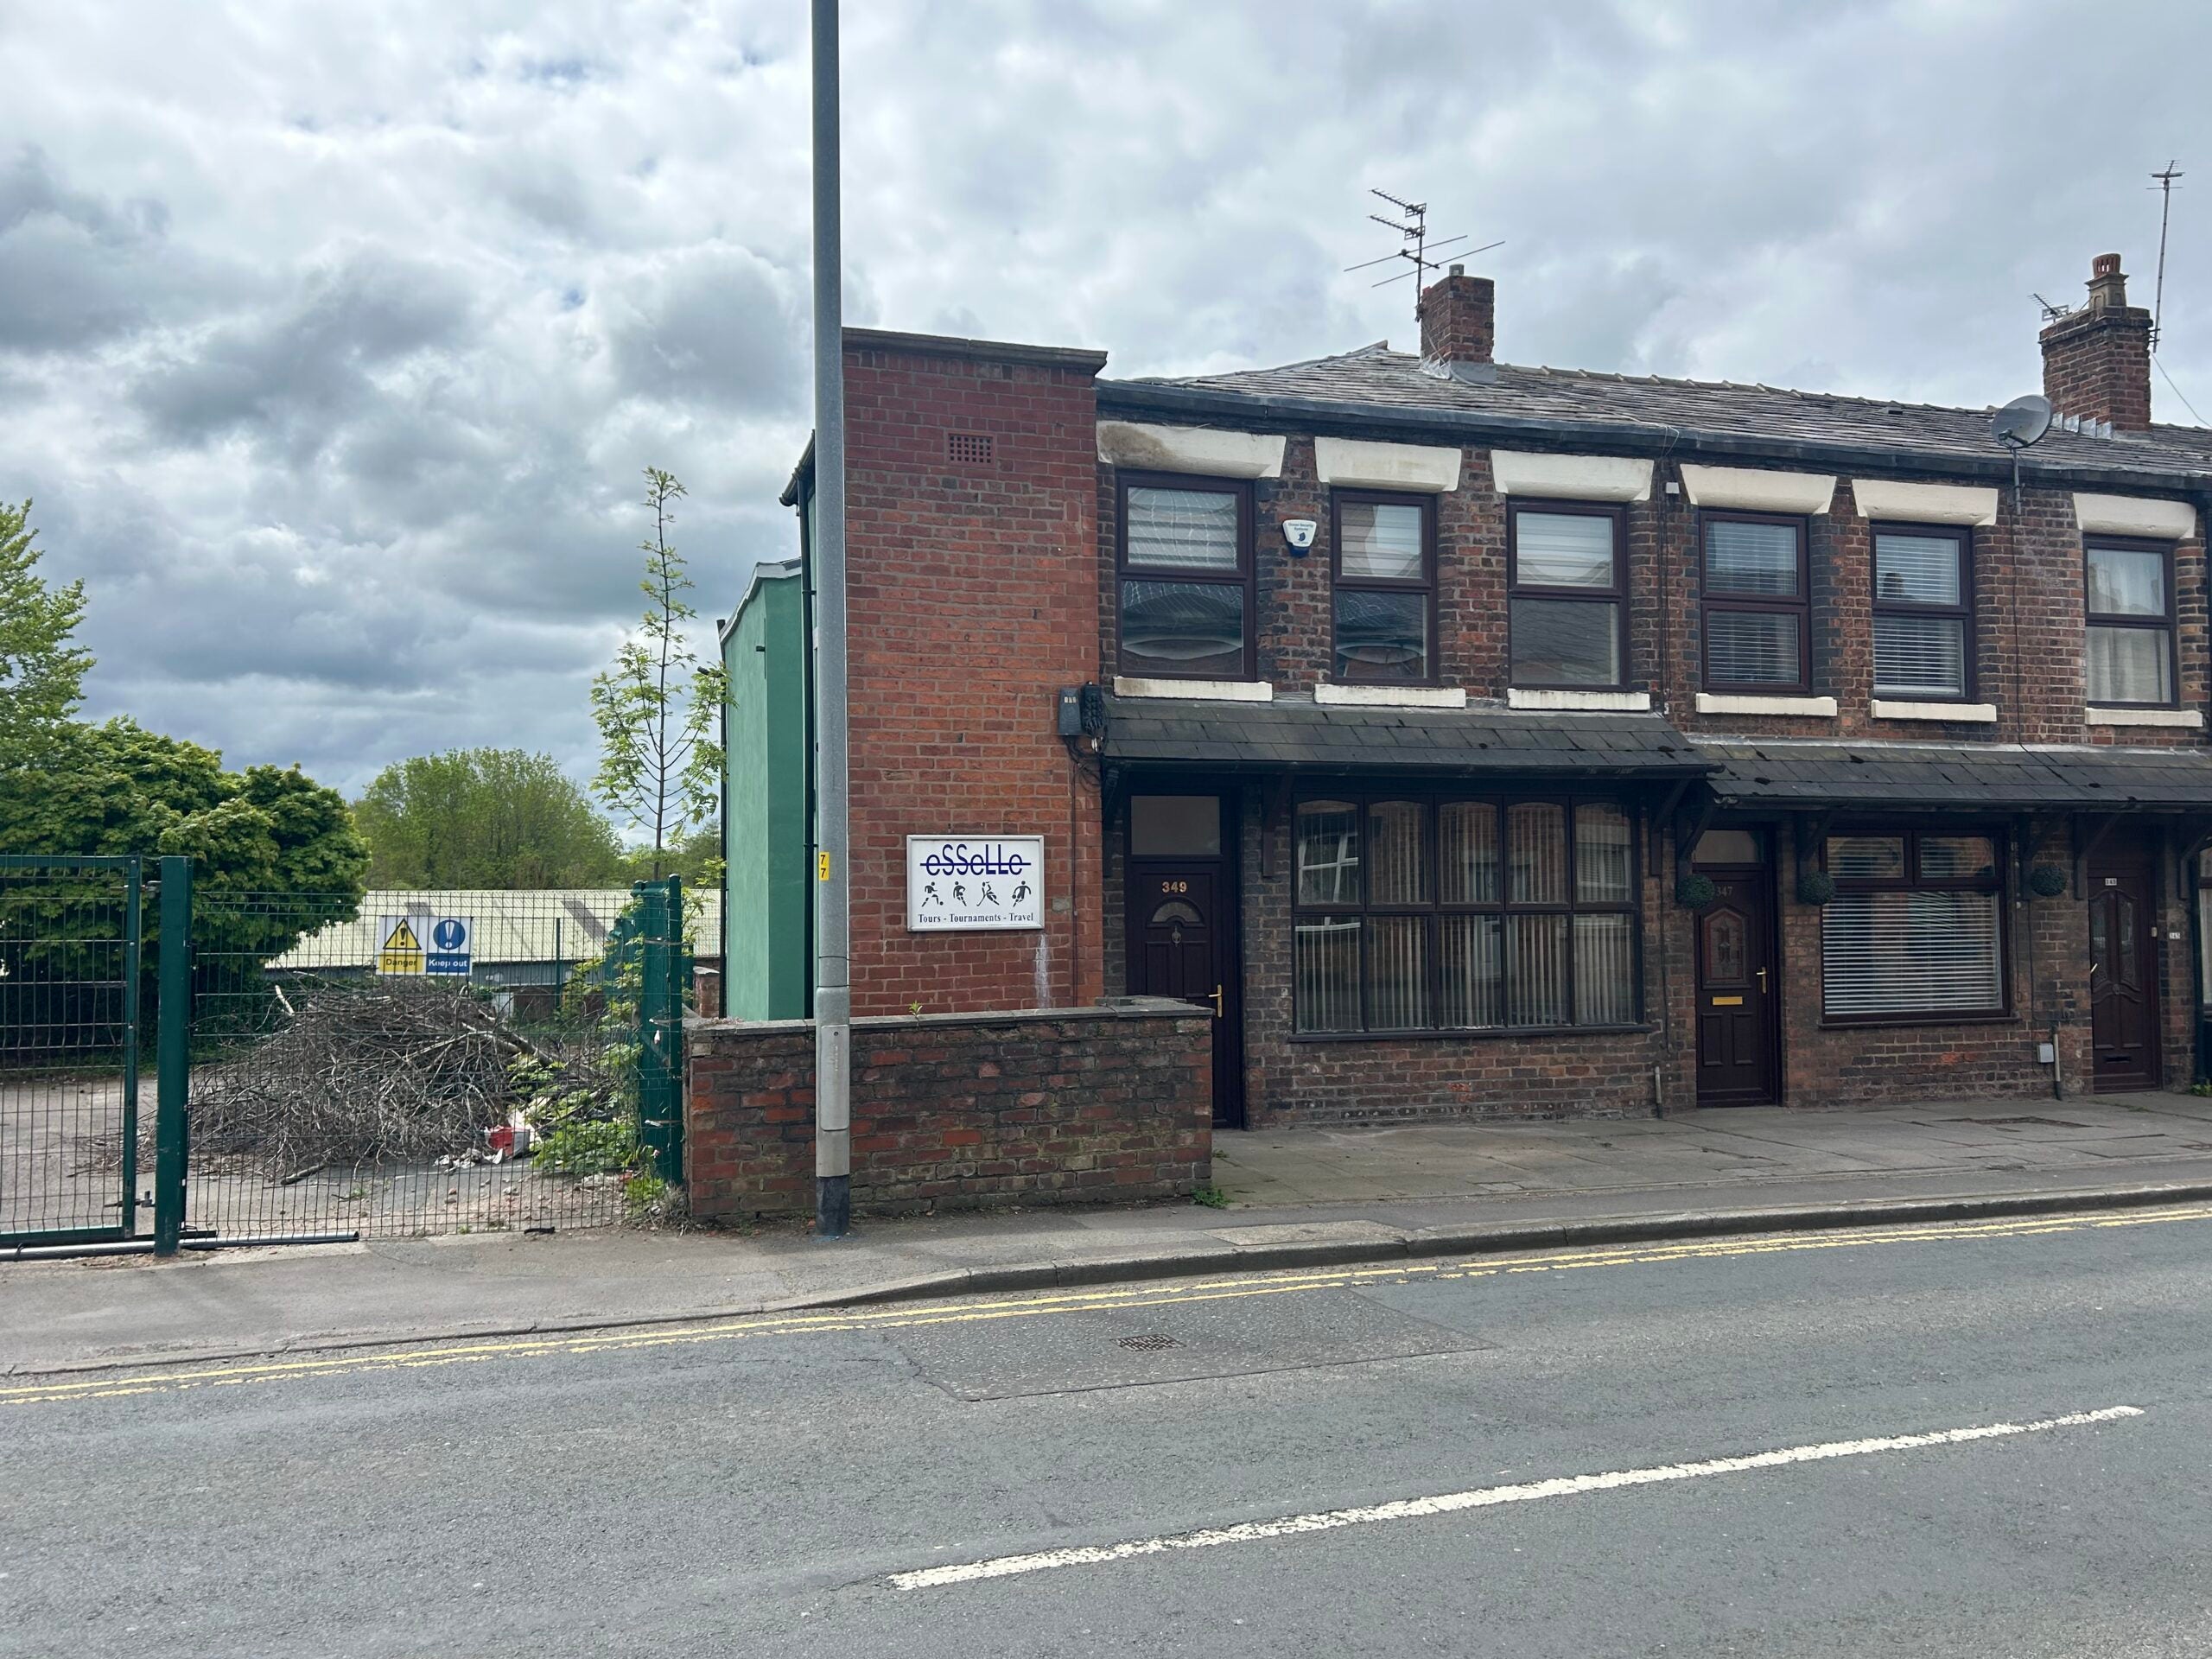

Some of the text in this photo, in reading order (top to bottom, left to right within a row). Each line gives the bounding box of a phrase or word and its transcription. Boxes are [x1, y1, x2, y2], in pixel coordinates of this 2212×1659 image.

[1161, 881, 1187, 893] 349
[1715, 886, 1733, 897] 347
[918, 913, 941, 923] Tours
[950, 913, 1001, 923] Tournaments
[1009, 912, 1033, 922] Travel
[386, 958, 417, 967] Danger
[429, 959, 450, 968] Keep
